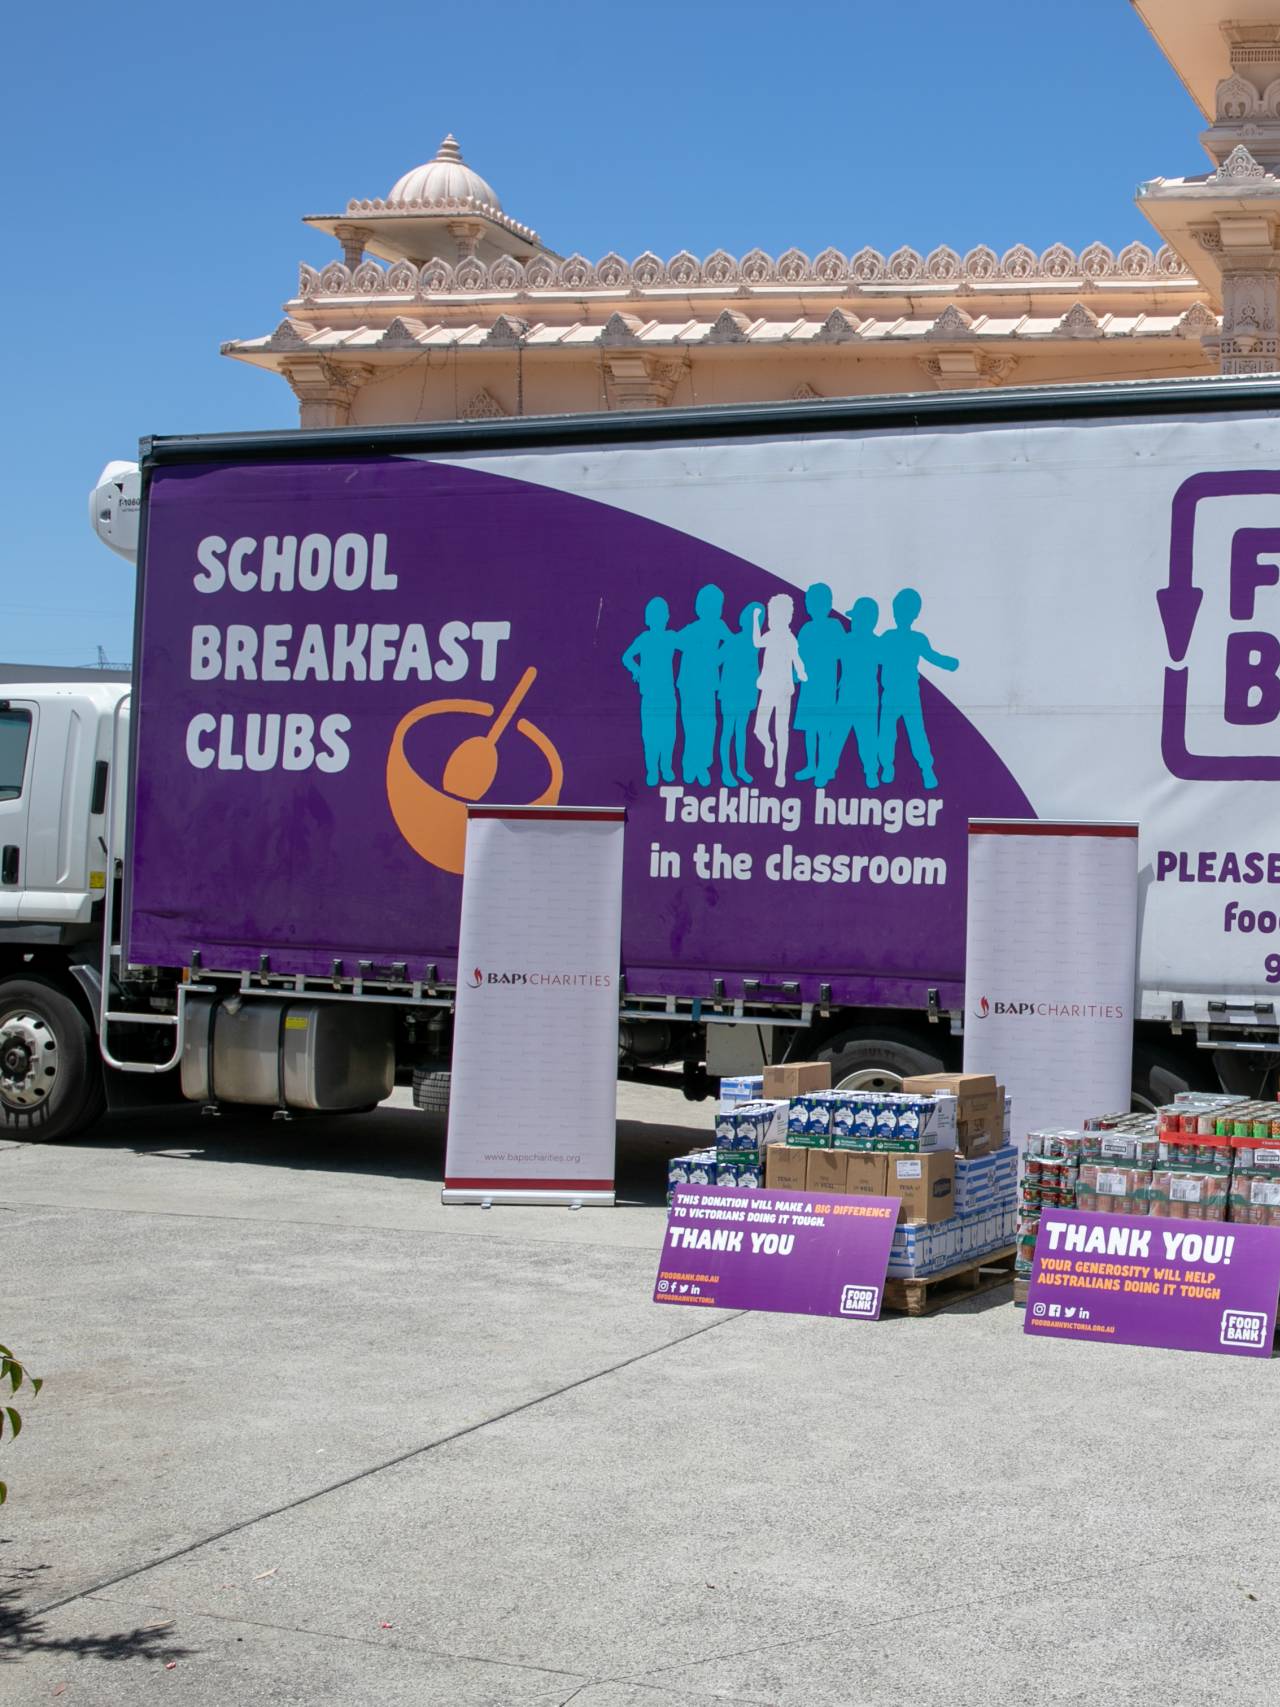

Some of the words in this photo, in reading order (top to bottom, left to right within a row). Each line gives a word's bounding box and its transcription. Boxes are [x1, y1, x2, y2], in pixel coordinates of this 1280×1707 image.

[194, 533, 397, 593] SCHOOL
[191, 621, 510, 681] BREAKFAST
[186, 713, 351, 772] CLUBS
[660, 785, 801, 831] Tackling
[815, 788, 943, 833] hunger
[650, 843, 681, 878] in
[693, 844, 752, 880] the
[766, 845, 946, 884] classroom
[484, 1152, 581, 1163] www.bapscharities.org
[674, 1207, 687, 1217] TO
[689, 1208, 745, 1221] VICTORIANS
[747, 1212, 776, 1223] DOING
[778, 1215, 790, 1224] IT
[792, 1215, 825, 1227] TOUGH.
[677, 1194, 700, 1205] THIS
[701, 1196, 749, 1208] DONATION
[751, 1199, 773, 1210] WILL
[775, 1201, 803, 1213] MAKE
[804, 1203, 812, 1213] A
[814, 1204, 831, 1214] BIG
[833, 1205, 892, 1218] DIFFERENCE
[670, 1227, 744, 1252] THANK
[751, 1232, 795, 1255] YOU
[1046, 1222, 1151, 1258] THANK
[1163, 1232, 1235, 1265] YOU!
[660, 1272, 720, 1283] FOODBANK.ORG.AU
[1040, 1258, 1071, 1272] YOUR
[1075, 1261, 1150, 1279] GENEROSITY
[1153, 1268, 1181, 1282] WILL
[1185, 1271, 1216, 1284] HELP
[847, 1290, 873, 1301] FOOD
[1037, 1273, 1120, 1291] AUSTRALIANS
[1124, 1280, 1160, 1295] DOING
[1163, 1284, 1177, 1296] IT
[1180, 1285, 1221, 1300] TOUGH
[845, 1299, 871, 1310] BANK
[1031, 1319, 1115, 1334] FOODBANKVICTORIA.ORG.AU
[1227, 1328, 1259, 1341] BANK
[1229, 1316, 1260, 1330] FOOD
